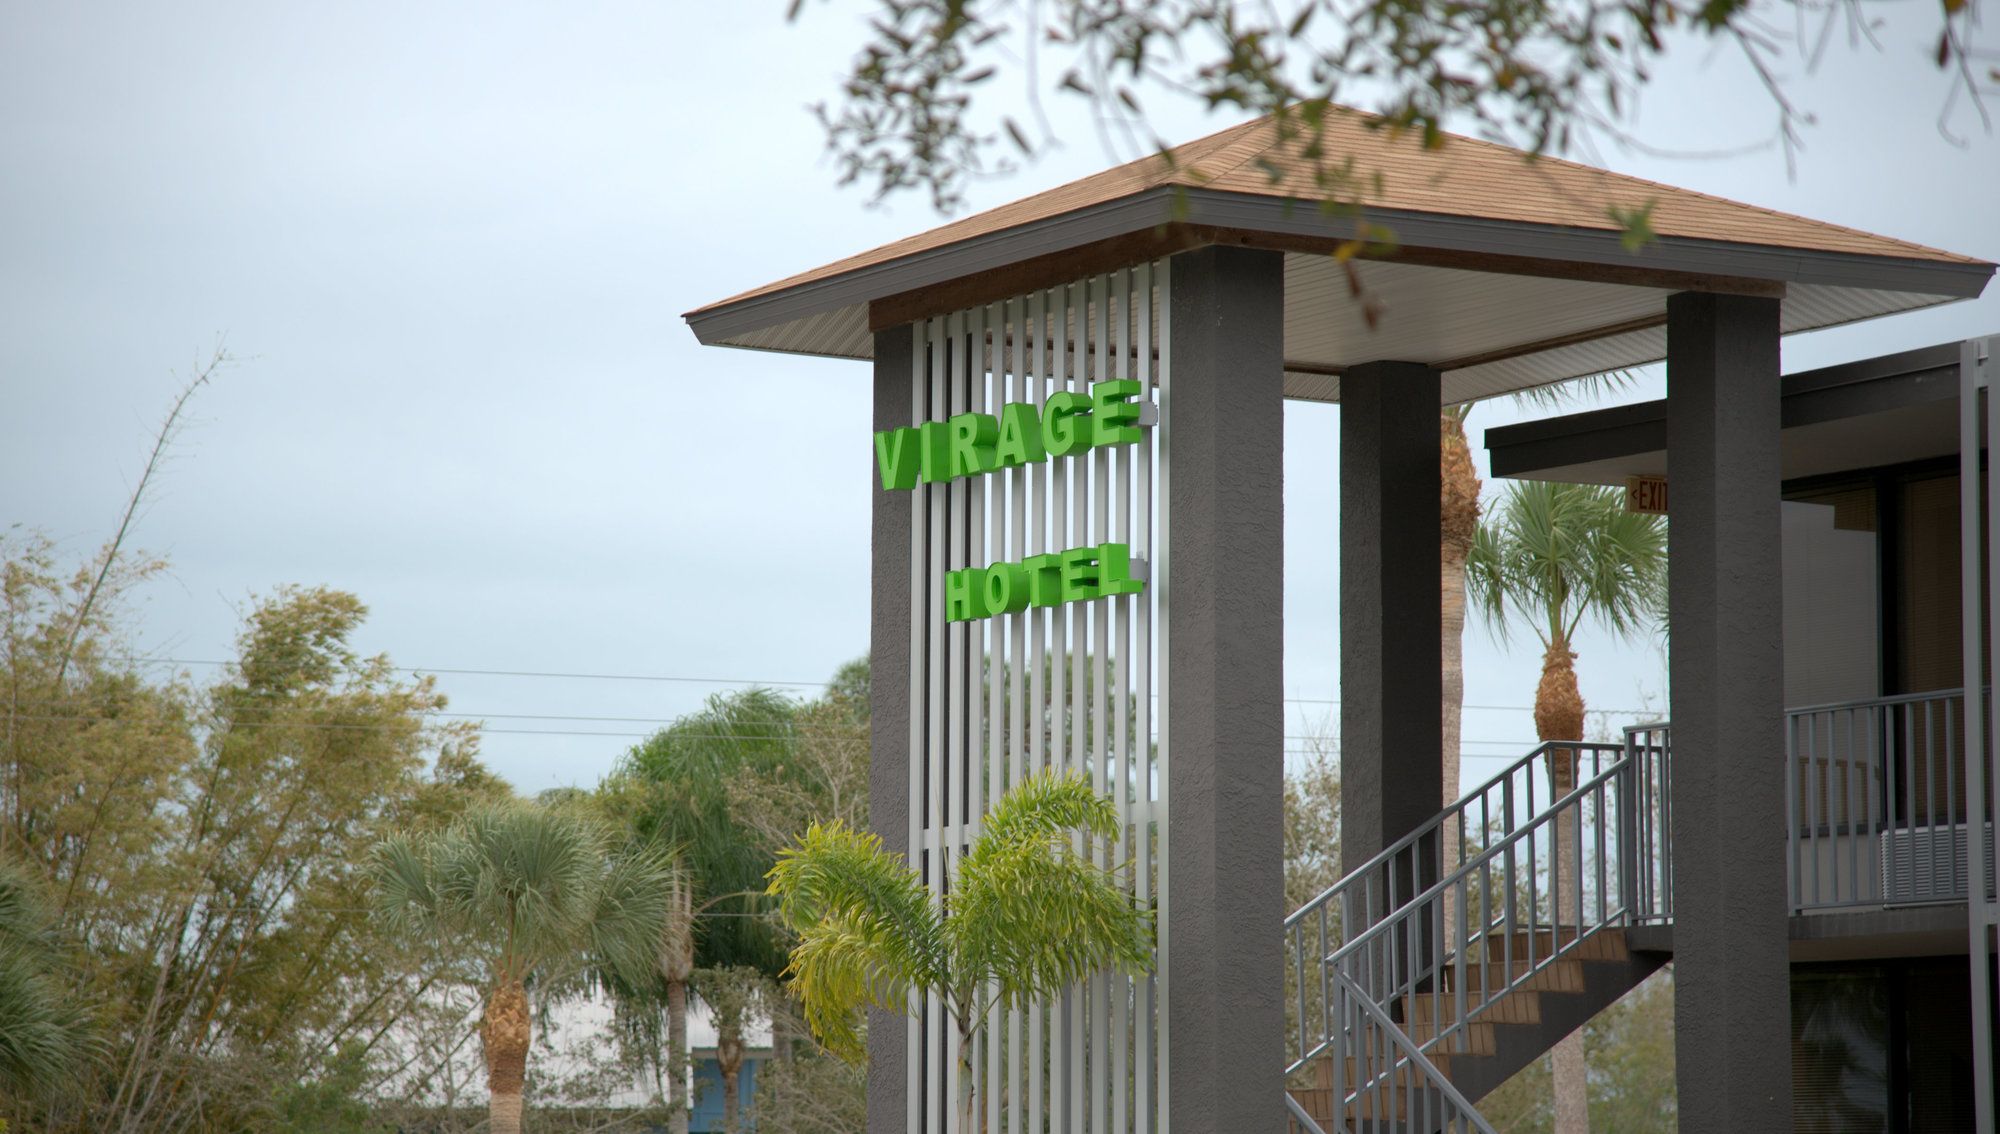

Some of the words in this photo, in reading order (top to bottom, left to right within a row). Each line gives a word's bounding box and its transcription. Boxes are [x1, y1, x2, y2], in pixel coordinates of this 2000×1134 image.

[874, 379, 1142, 491] VIRAGE
[1639, 480, 1668, 511] EXIT
[946, 542, 1143, 623] HOTEL
